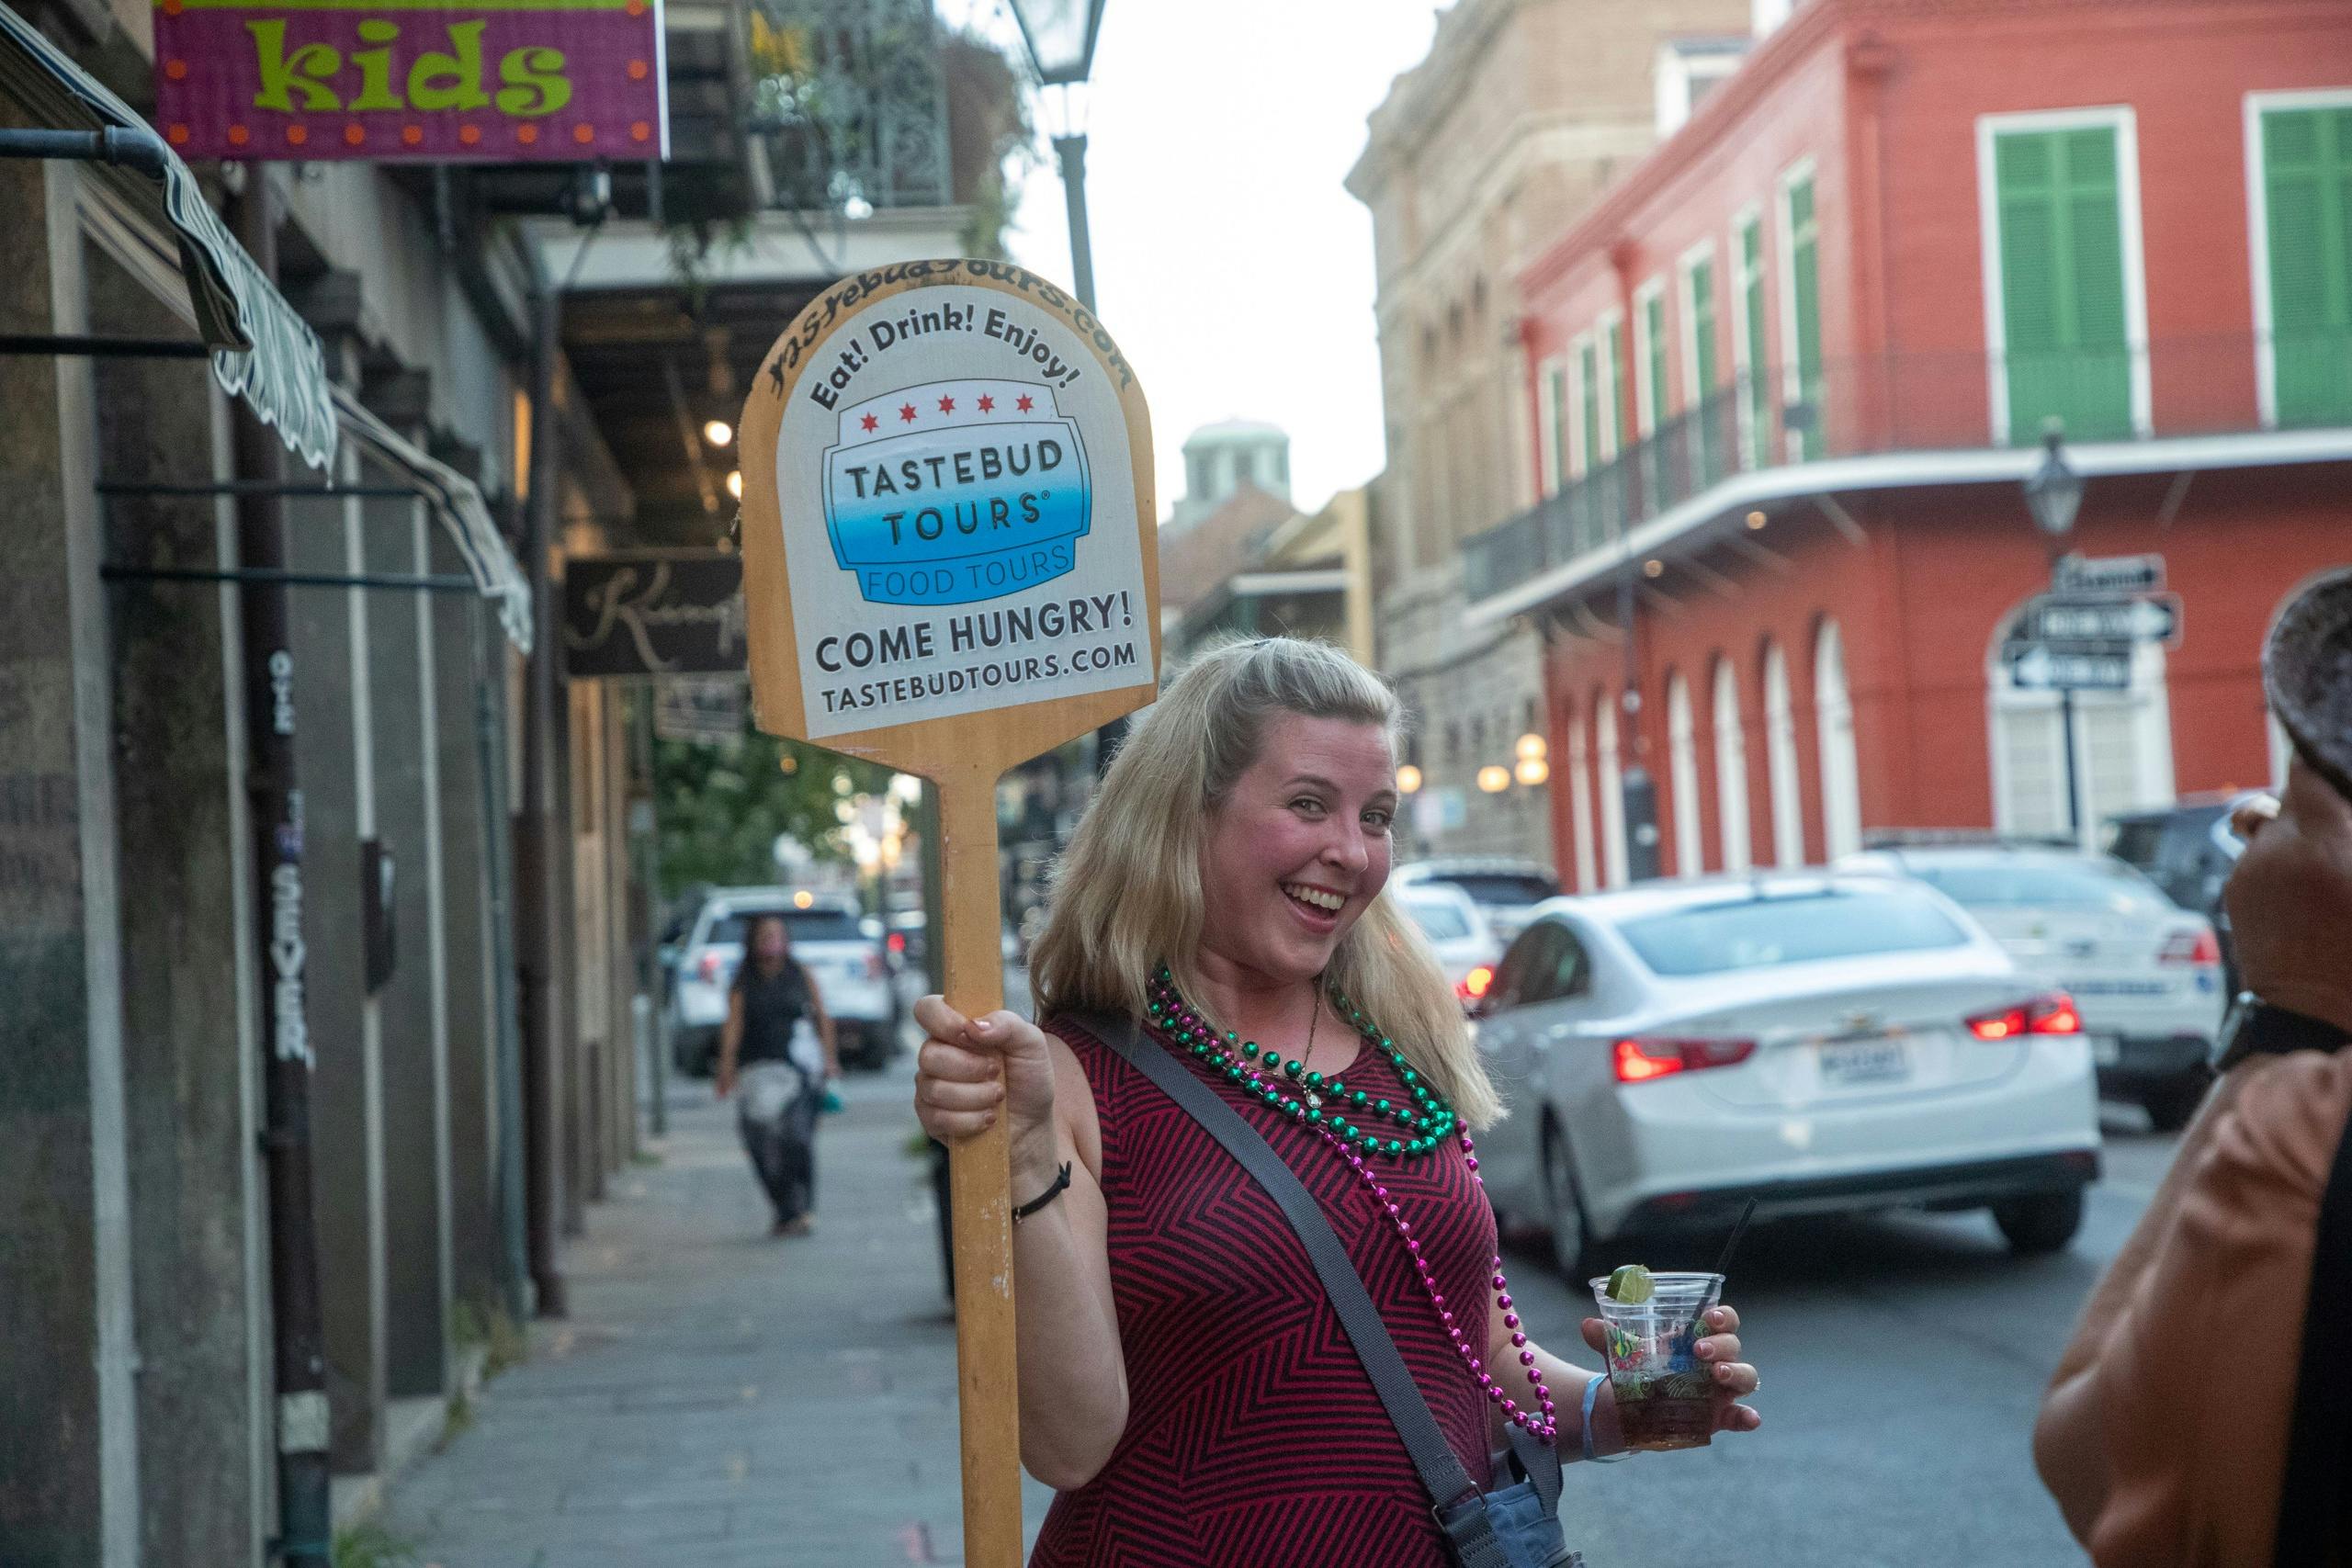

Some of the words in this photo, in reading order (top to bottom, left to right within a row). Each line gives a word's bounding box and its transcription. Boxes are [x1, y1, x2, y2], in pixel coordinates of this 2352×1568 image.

[244, 18, 571, 118] kids
[809, 339, 869, 411] Eat!
[869, 303, 974, 351] Drink!
[984, 308, 1080, 389] Enjoy!
[844, 439, 1063, 499] TASTEBUD
[867, 569, 955, 596] FOOD
[967, 545, 1069, 589] TOURS
[815, 621, 934, 672] COME
[949, 591, 1132, 653] HUNGRY!
[821, 642, 1136, 713] TASTEBUDTOURS.COM
